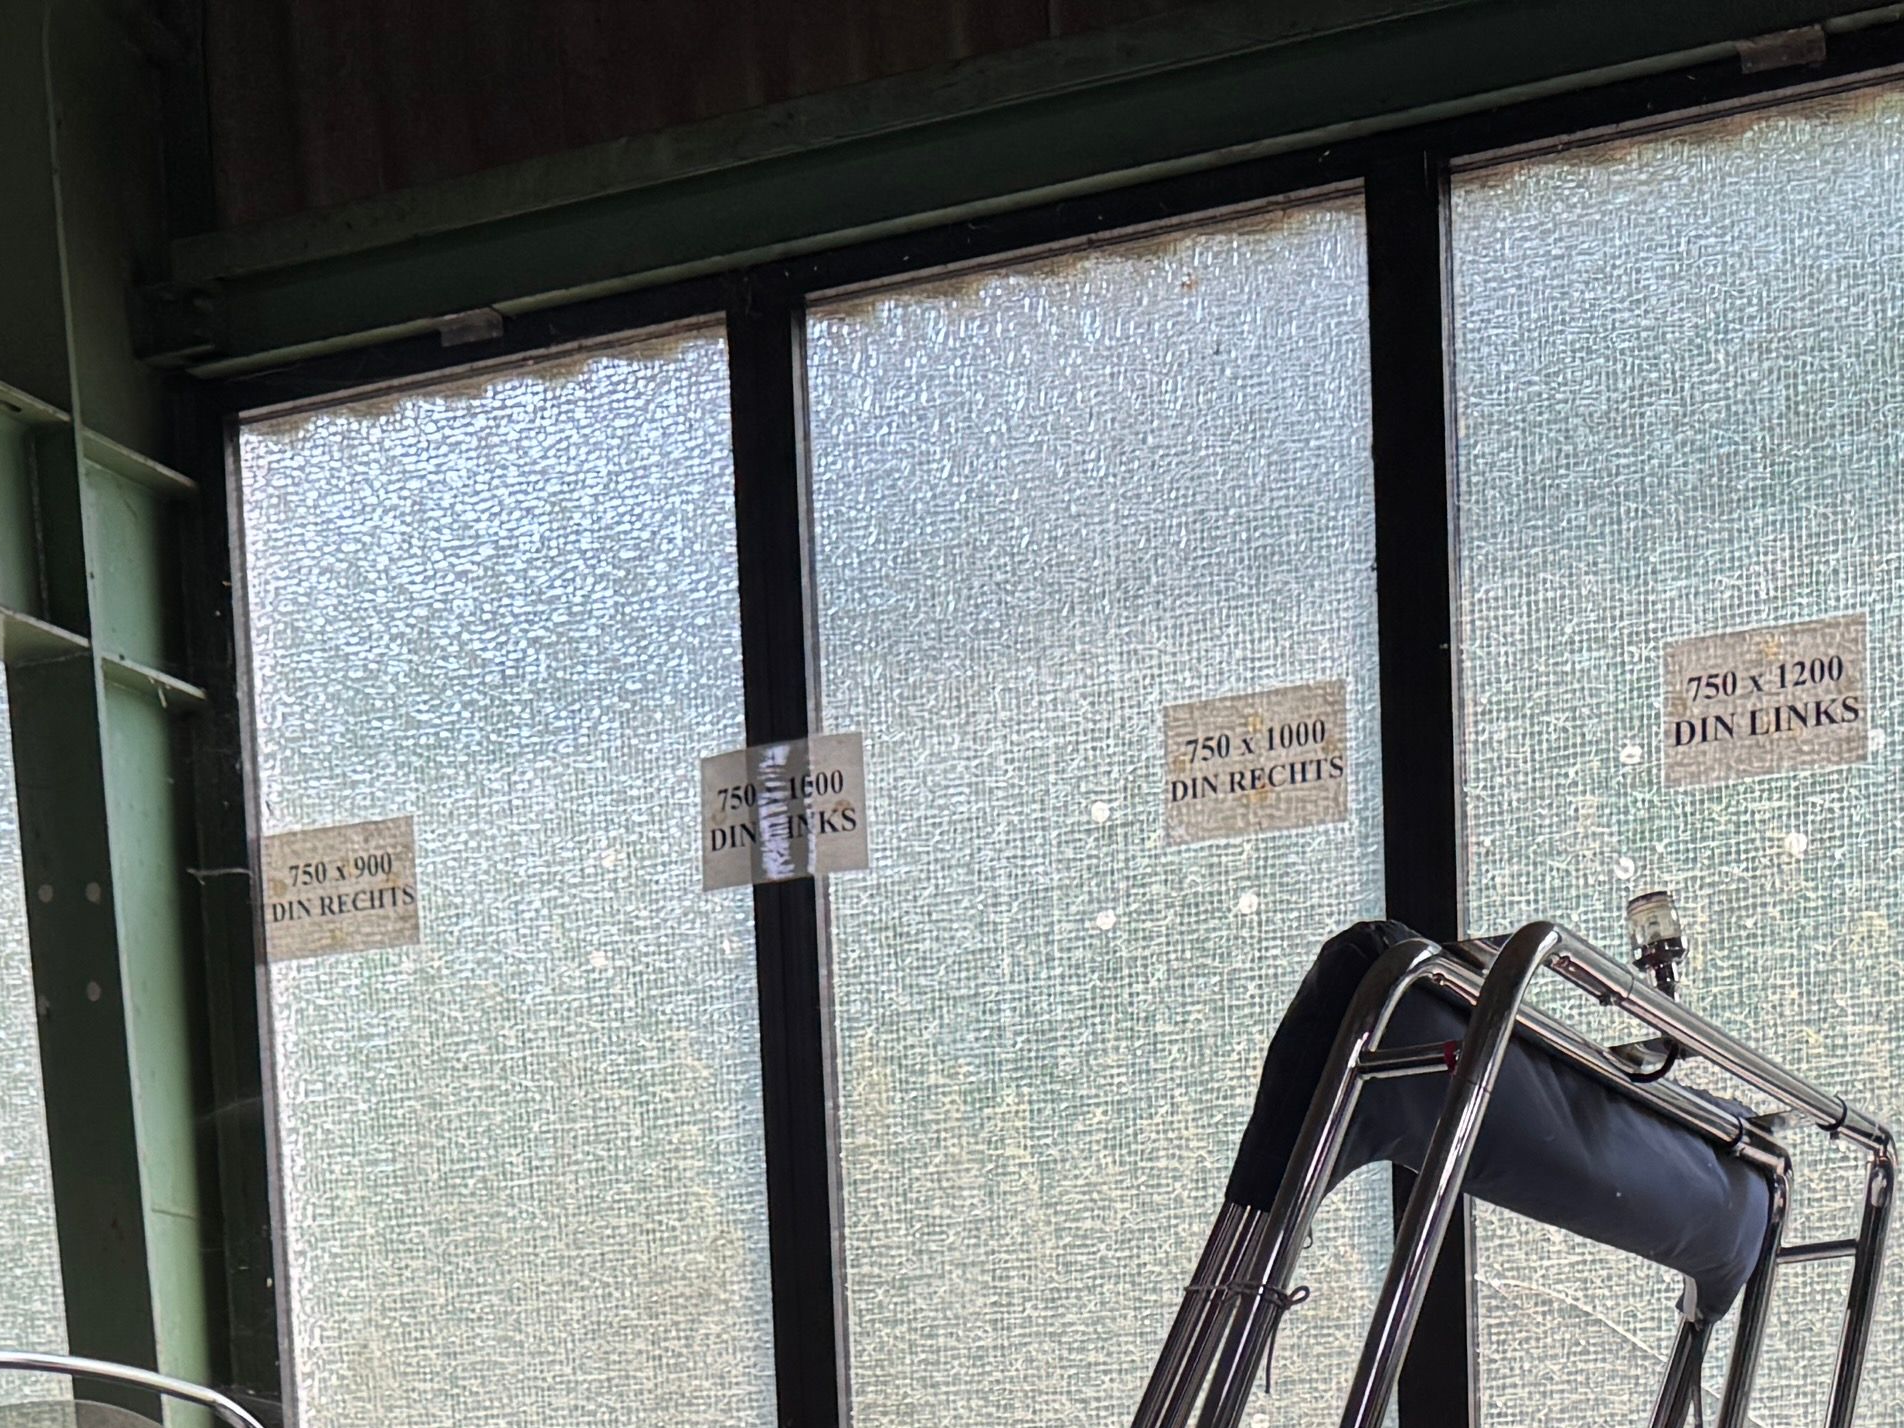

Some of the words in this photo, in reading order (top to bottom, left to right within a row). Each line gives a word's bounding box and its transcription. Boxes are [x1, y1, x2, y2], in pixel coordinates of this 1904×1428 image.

[1687, 671, 1737, 703] 750
[1749, 673, 1764, 692] x
[1778, 655, 1844, 690] 1200
[1186, 733, 1231, 764] 750
[1240, 737, 1255, 756] x
[1267, 719, 1326, 751] 1000
[1674, 712, 1736, 748] DIN
[1749, 696, 1860, 736] LINKS
[718, 783, 756, 812] 750
[1171, 774, 1218, 803] DIN
[1229, 755, 1344, 793] RECHTS
[711, 821, 757, 851] DIN
[771, 807, 857, 841] INKS
[289, 861, 327, 887] 750
[354, 852, 392, 878] 900
[272, 899, 311, 923] DIN
[320, 884, 415, 916] RECHTS
